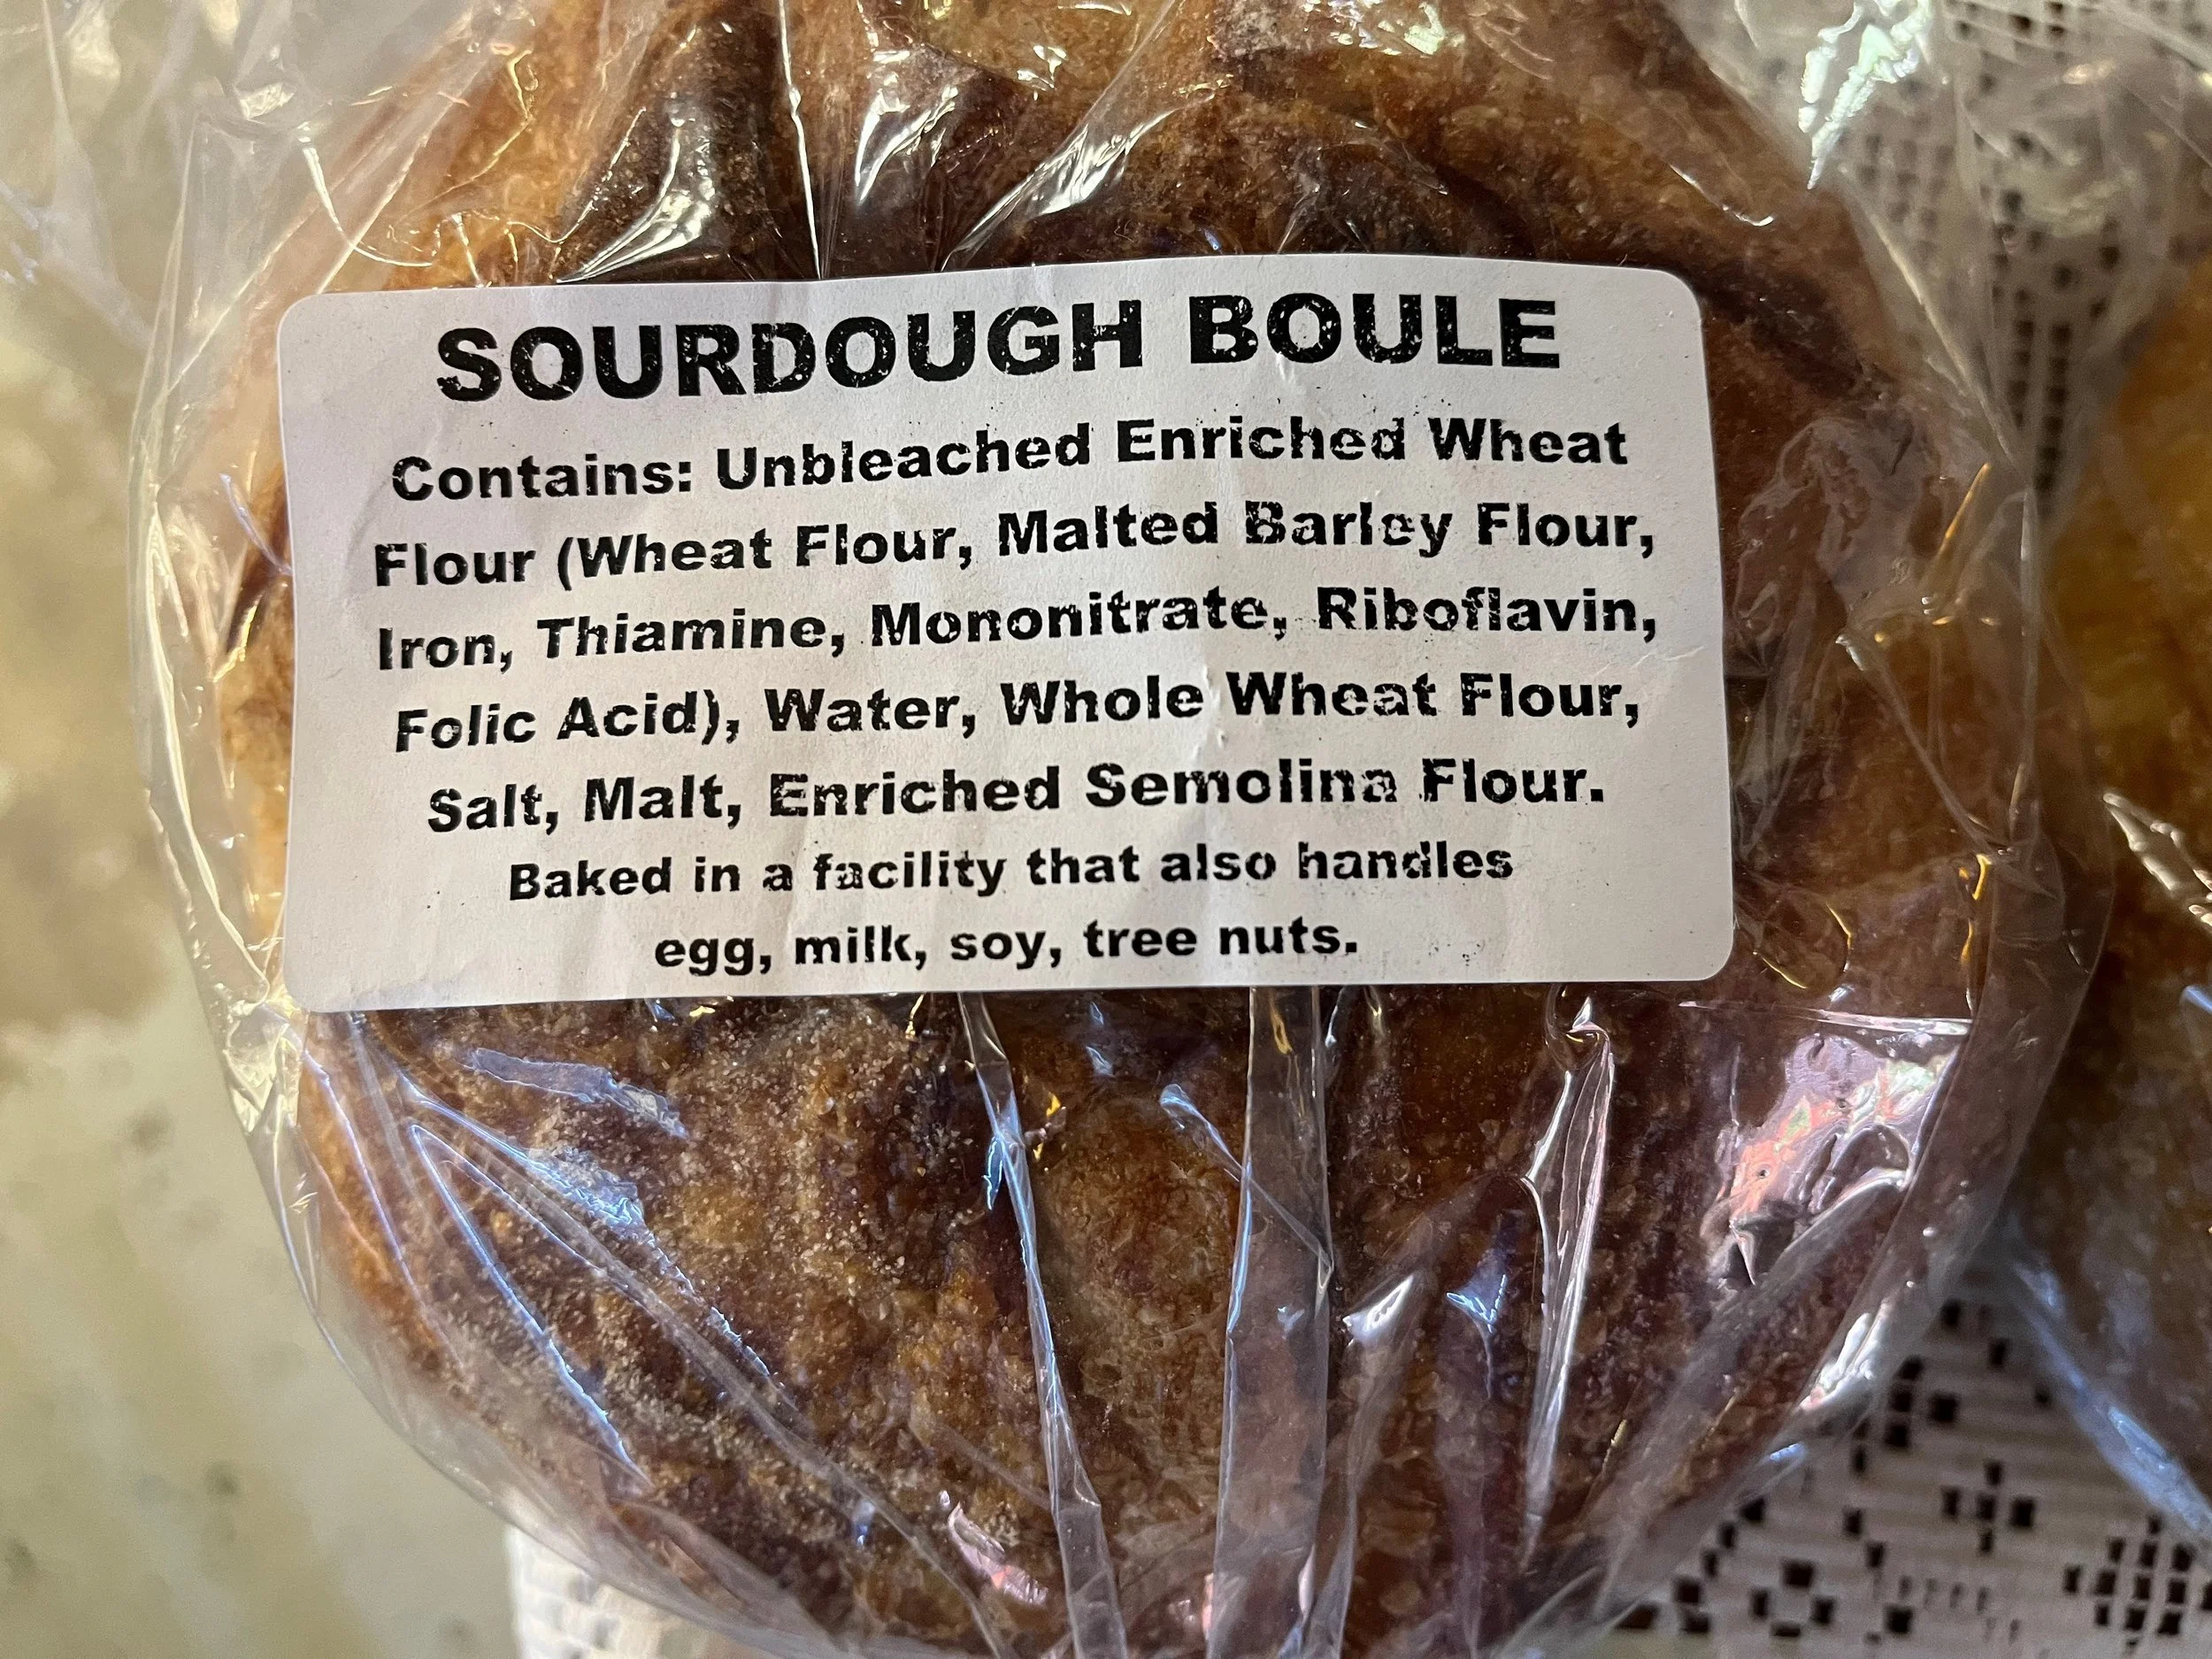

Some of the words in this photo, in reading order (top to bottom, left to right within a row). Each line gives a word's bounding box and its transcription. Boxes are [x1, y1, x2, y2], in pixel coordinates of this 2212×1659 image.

[437, 300, 1142, 402] SOURDOUGH
[1189, 293, 1560, 368] BOULE
[392, 454, 690, 501] Contains:
[718, 423, 1089, 489] Unbleached
[1118, 416, 1405, 462] Enriched
[1428, 418, 1627, 465] Wheat
[375, 543, 535, 587] Flour
[557, 528, 772, 590] (Wheat
[796, 524, 972, 570] Flour,
[999, 502, 1217, 556] Malted
[1246, 501, 1453, 557] Barley
[1478, 503, 1653, 558] Flour,
[380, 628, 512, 672] Iron,
[537, 609, 844, 658] Thiamine,
[872, 586, 1286, 646] Mononitrate,
[1317, 587, 1655, 643] Riboflavin,
[396, 703, 535, 752] Folic
[557, 689, 739, 745] Acid),
[764, 689, 975, 739] Water,
[1001, 675, 1203, 725] Whole
[1226, 672, 1437, 716] Wheat
[1461, 672, 1638, 728] Flour,
[428, 784, 557, 835] Salt,
[585, 774, 741, 829] Malt,
[771, 766, 1059, 817] Enriched
[1087, 758, 1397, 807] Semolina
[1419, 758, 1603, 804] Flour.
[510, 857, 672, 900] Baked
[695, 856, 740, 892] in
[763, 864, 793, 891] a
[813, 850, 1006, 896] facility
[1027, 846, 1140, 885] that
[1161, 843, 1276, 882] also
[1299, 841, 1513, 879] handles
[656, 939, 771, 976] egg,
[795, 926, 926, 971] milk,
[951, 932, 1061, 970] soy,
[1084, 920, 1196, 957] tree
[1220, 917, 1356, 956] nuts.
